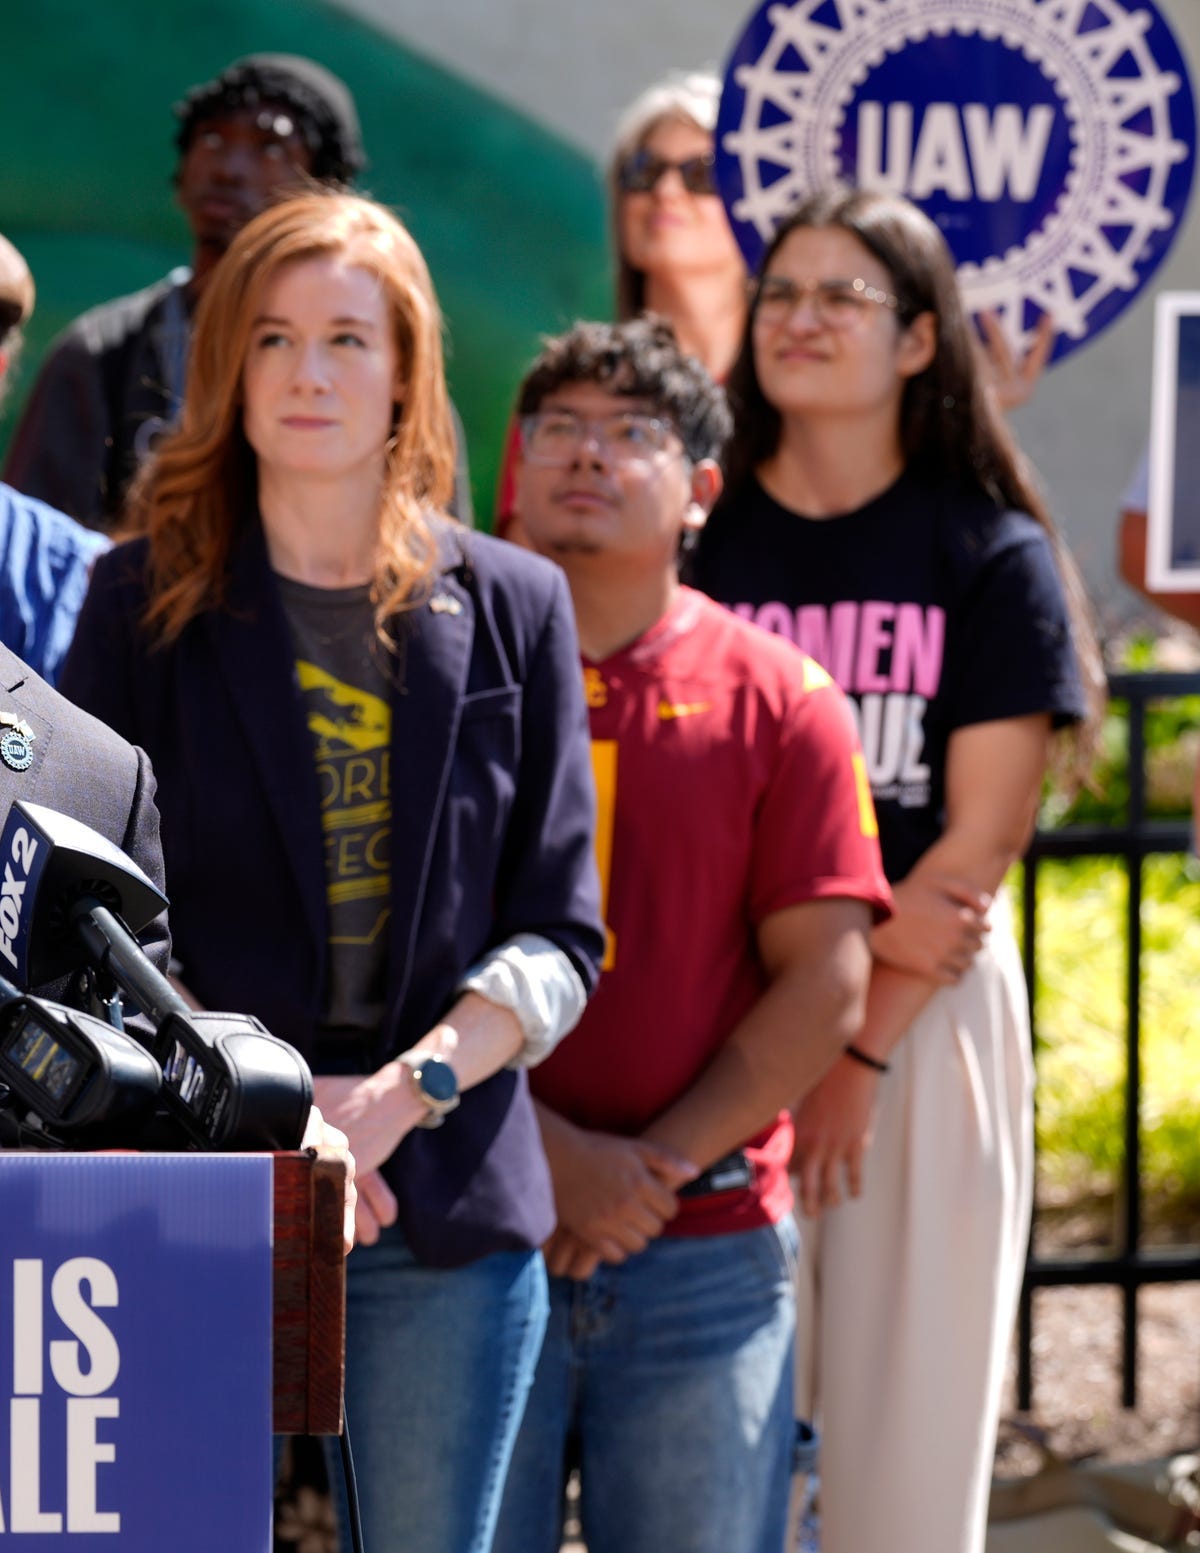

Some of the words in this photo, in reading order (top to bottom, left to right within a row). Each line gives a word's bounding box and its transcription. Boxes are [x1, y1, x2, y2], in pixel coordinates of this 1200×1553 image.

[857, 101, 1055, 202] UAW
[12, 827, 38, 876] 2
[13, 1256, 120, 1397] IS
